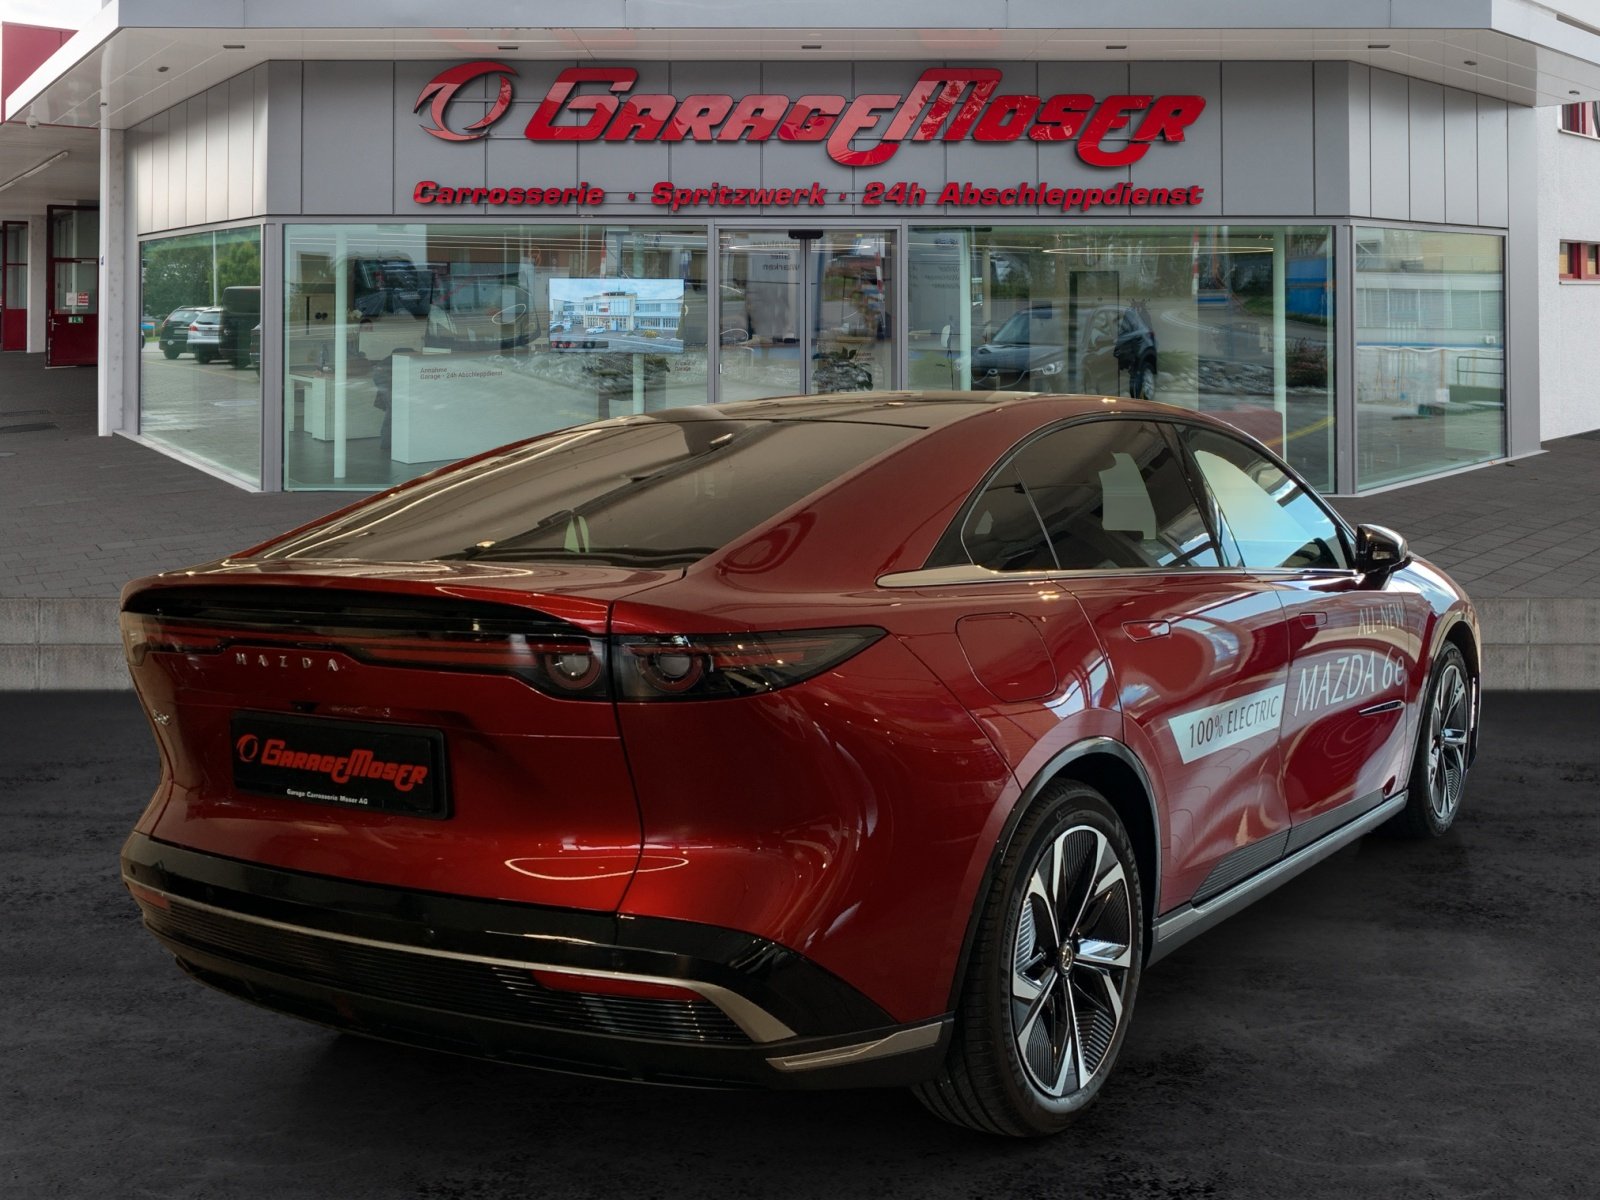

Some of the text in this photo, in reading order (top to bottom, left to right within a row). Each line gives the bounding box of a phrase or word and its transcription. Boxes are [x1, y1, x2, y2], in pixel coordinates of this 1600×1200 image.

[413, 181, 1205, 212] Carrosserie Spritzwerk 24h Abschleppdienst
[1358, 602, 1404, 636] ALL-NEW
[235, 652, 339, 672] MAZDA
[1294, 647, 1404, 716] MAZDA 6e
[1189, 695, 1279, 748] 100% ELECTRIC
[287, 788, 305, 797] Garage
[339, 795, 358, 803] Moser
[359, 797, 368, 805] AG
